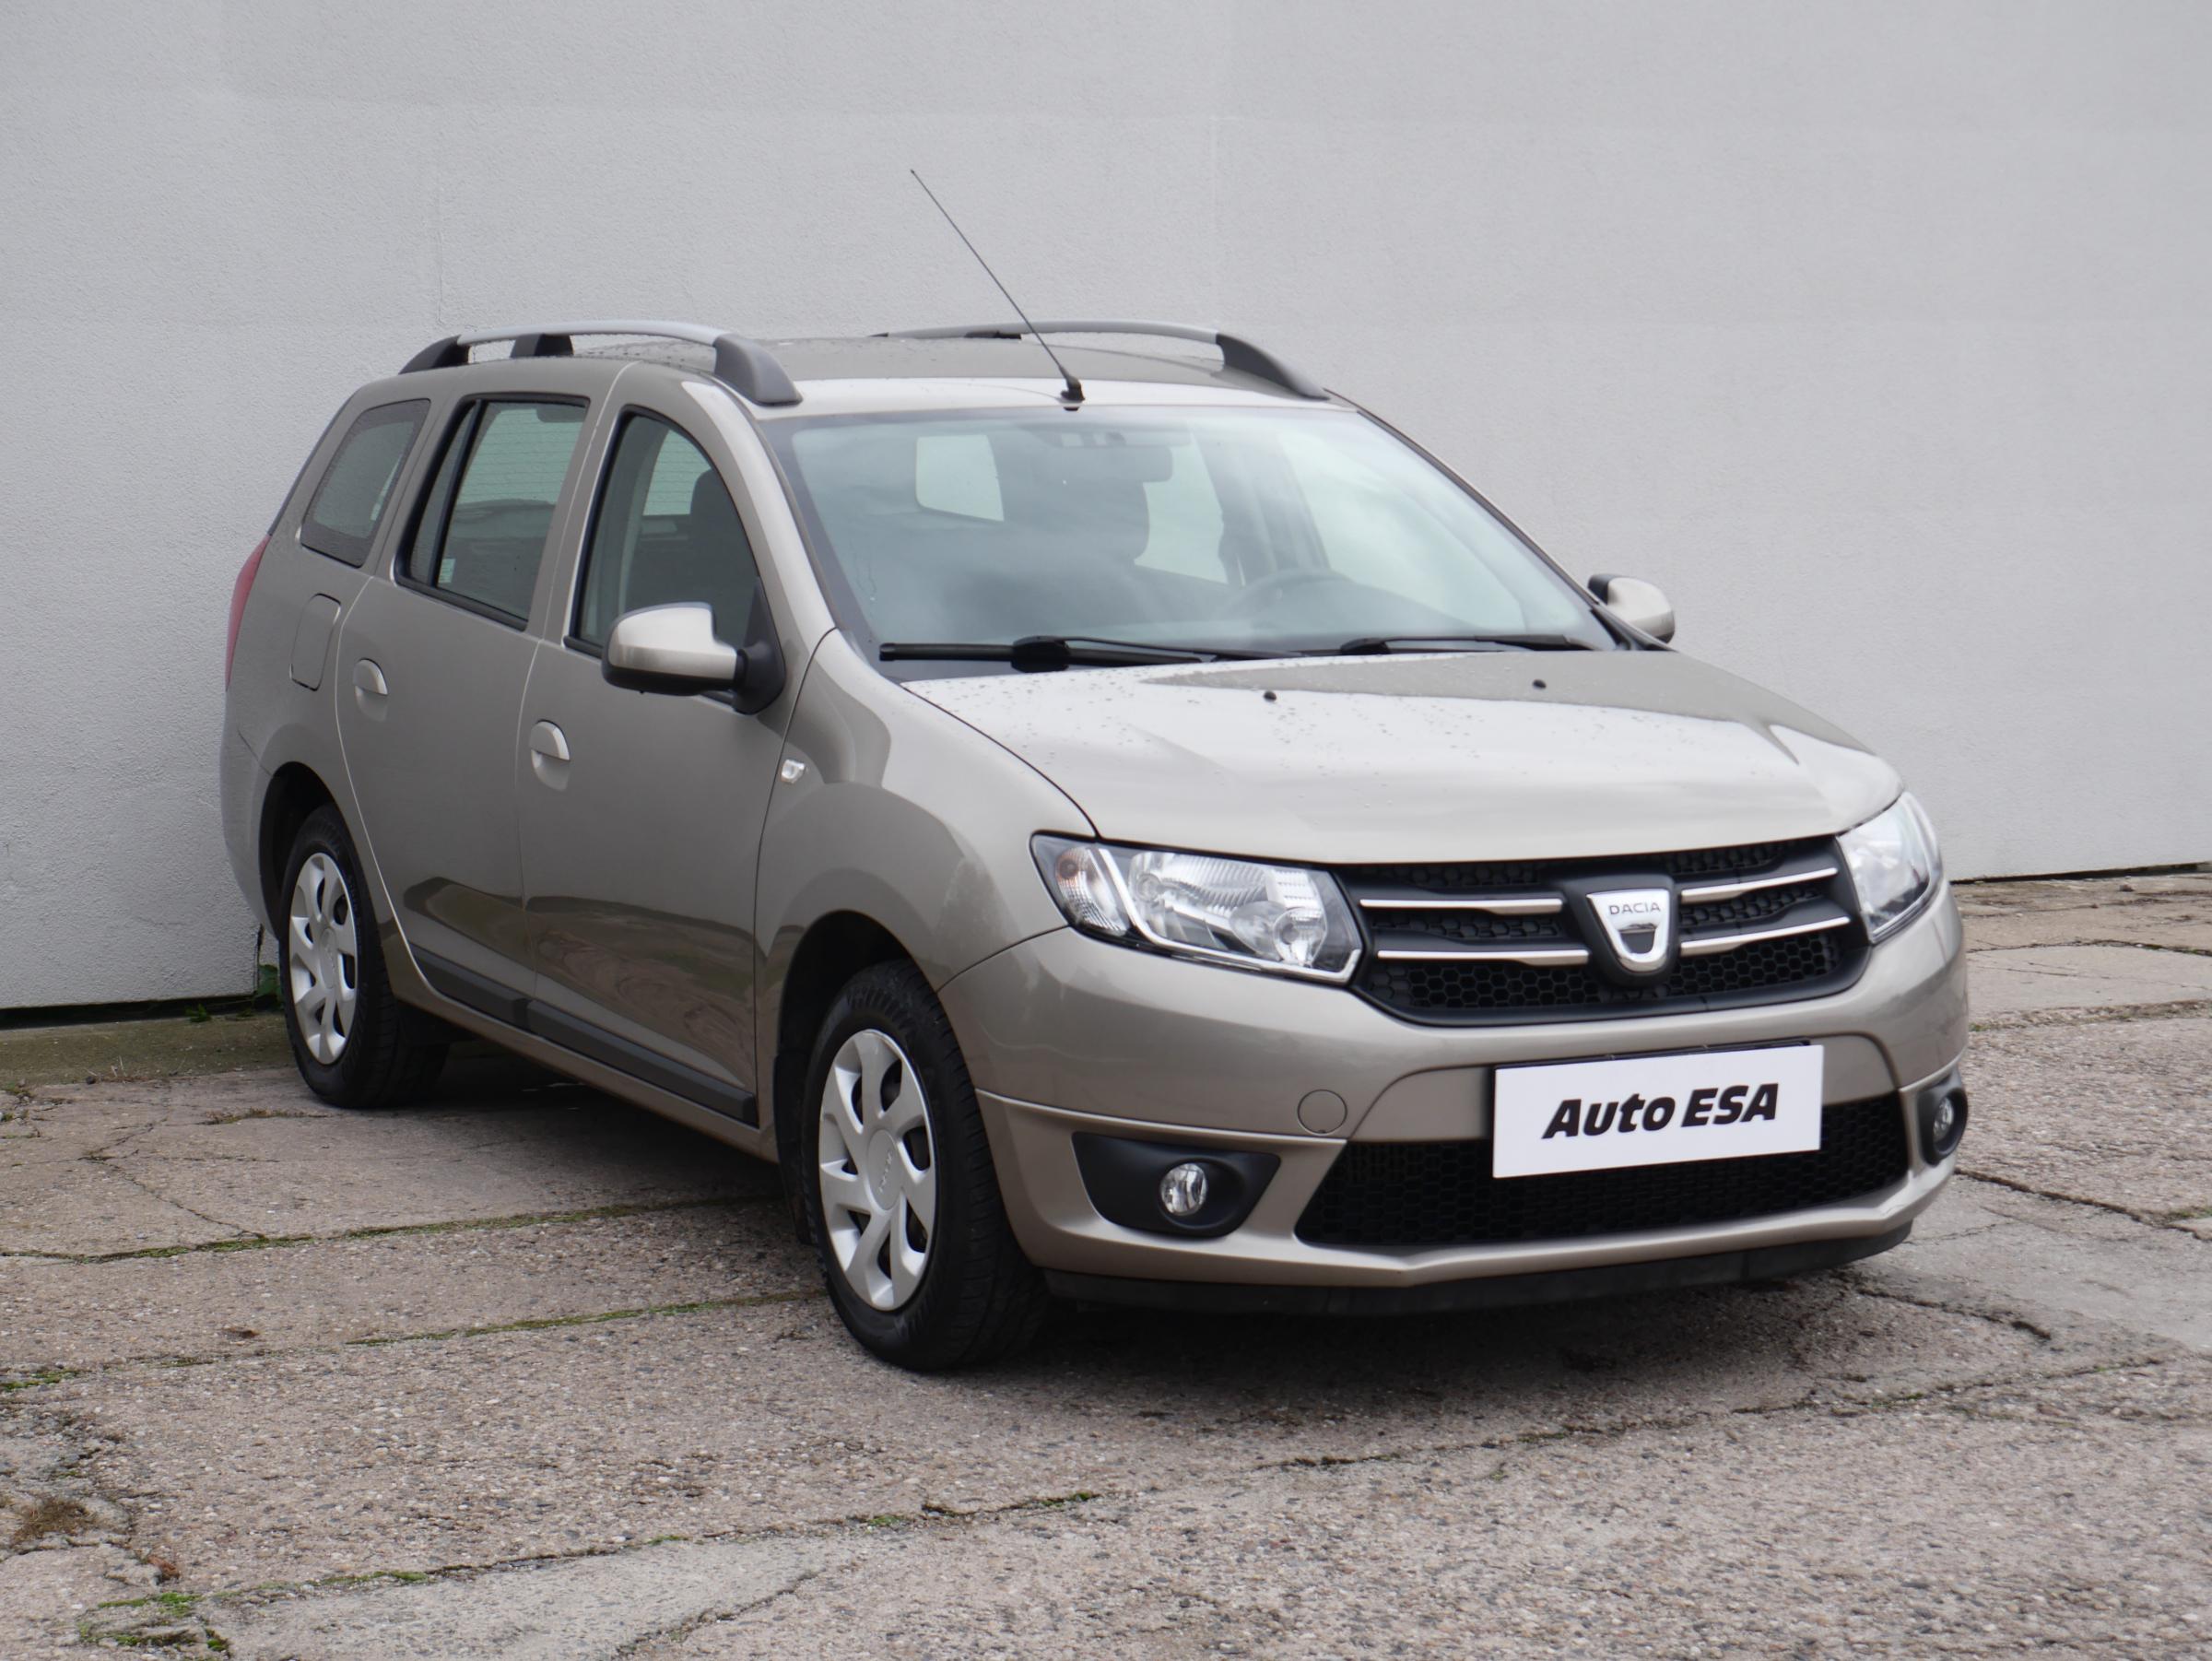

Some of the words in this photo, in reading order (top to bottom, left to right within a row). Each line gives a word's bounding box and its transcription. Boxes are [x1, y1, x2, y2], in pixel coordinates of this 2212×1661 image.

[1608, 902, 1661, 915] DACIA
[1541, 1093, 1676, 1139] Auto
[1680, 1083, 1779, 1128] ESA
